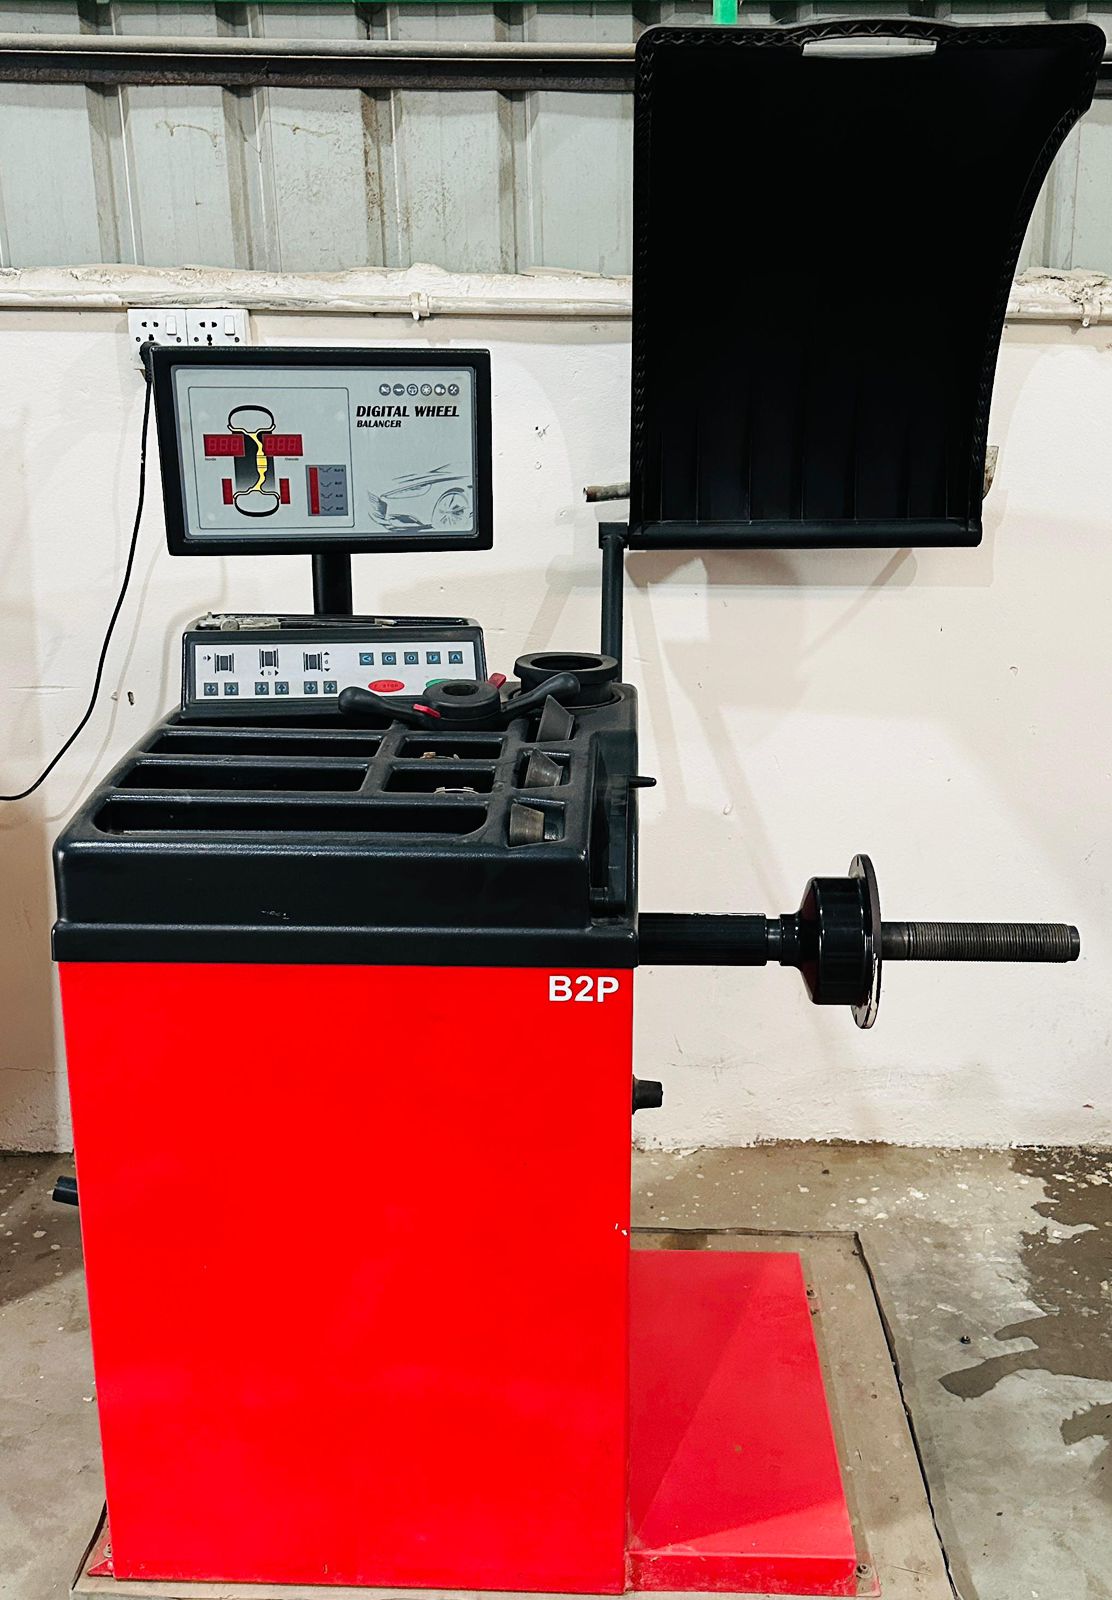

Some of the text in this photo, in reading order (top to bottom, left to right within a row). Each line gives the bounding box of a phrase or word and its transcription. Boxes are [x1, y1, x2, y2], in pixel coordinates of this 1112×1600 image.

[356, 406, 459, 417] DIGITAL WHEEL
[356, 420, 402, 428] BALANCER
[549, 975, 619, 1003] B2P
